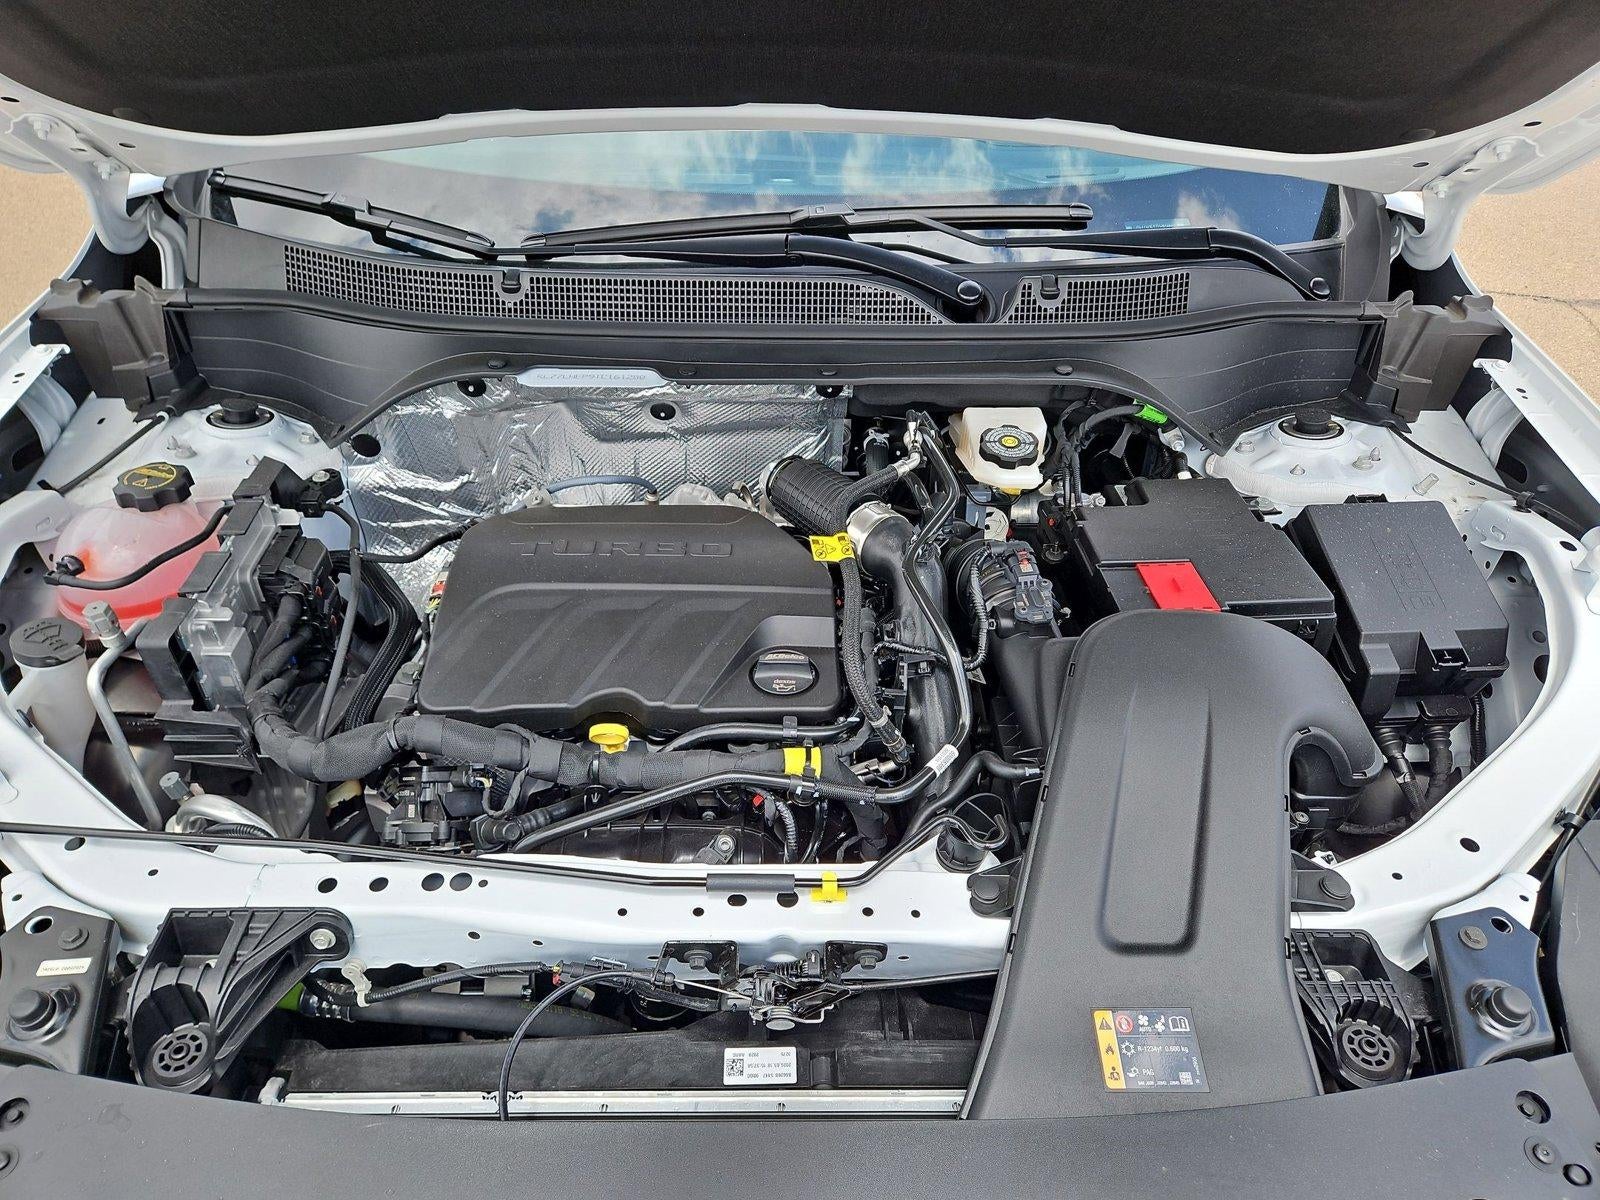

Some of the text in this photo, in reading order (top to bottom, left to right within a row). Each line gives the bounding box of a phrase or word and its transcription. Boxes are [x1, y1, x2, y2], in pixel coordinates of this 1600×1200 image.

[510, 542, 733, 557] TURBO
[1137, 1045, 1162, 1053] R-1234yf
[1181, 1045, 1189, 1054] kg
